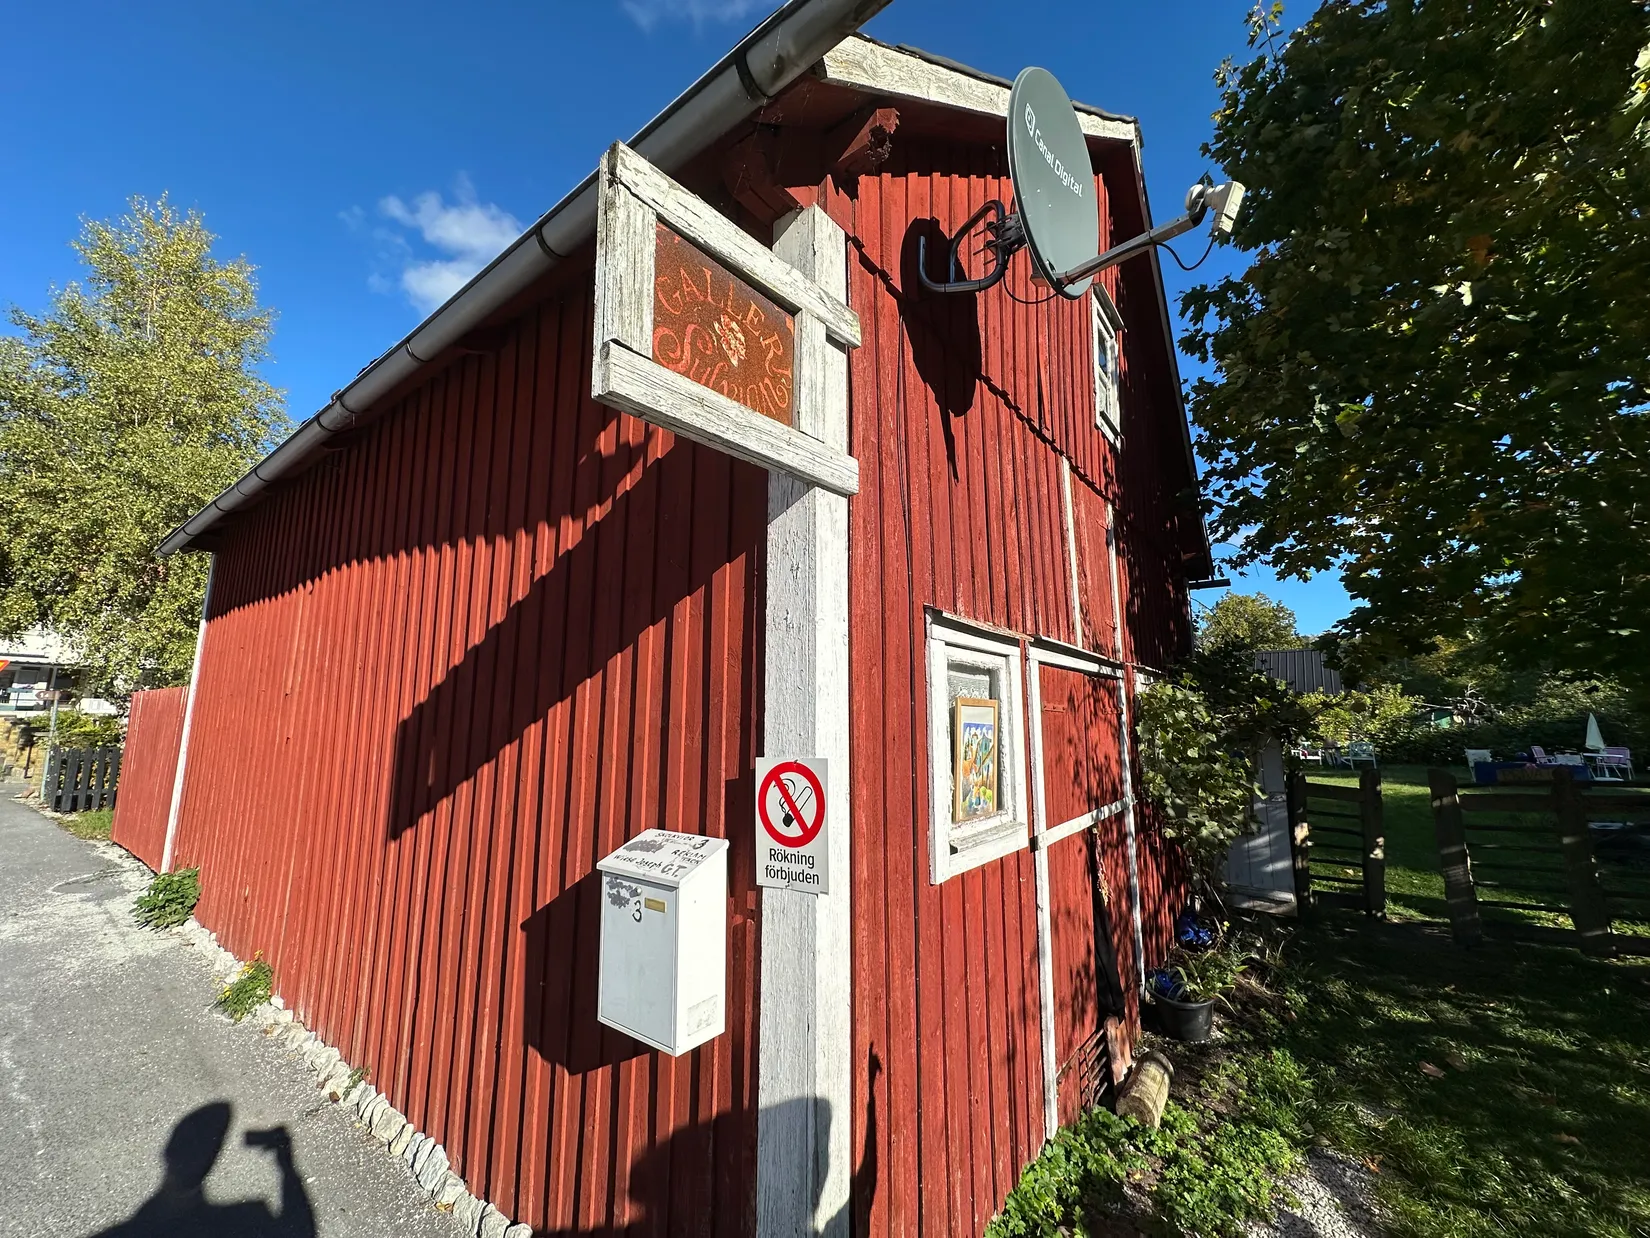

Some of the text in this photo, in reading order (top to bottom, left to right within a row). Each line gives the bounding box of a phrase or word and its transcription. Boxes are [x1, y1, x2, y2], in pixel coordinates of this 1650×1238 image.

[1034, 128, 1083, 198] Canal Digital
[692, 839, 710, 850] 3
[769, 848, 815, 870] Rökning
[765, 864, 820, 885] förbjuden
[632, 899, 642, 923] 3
